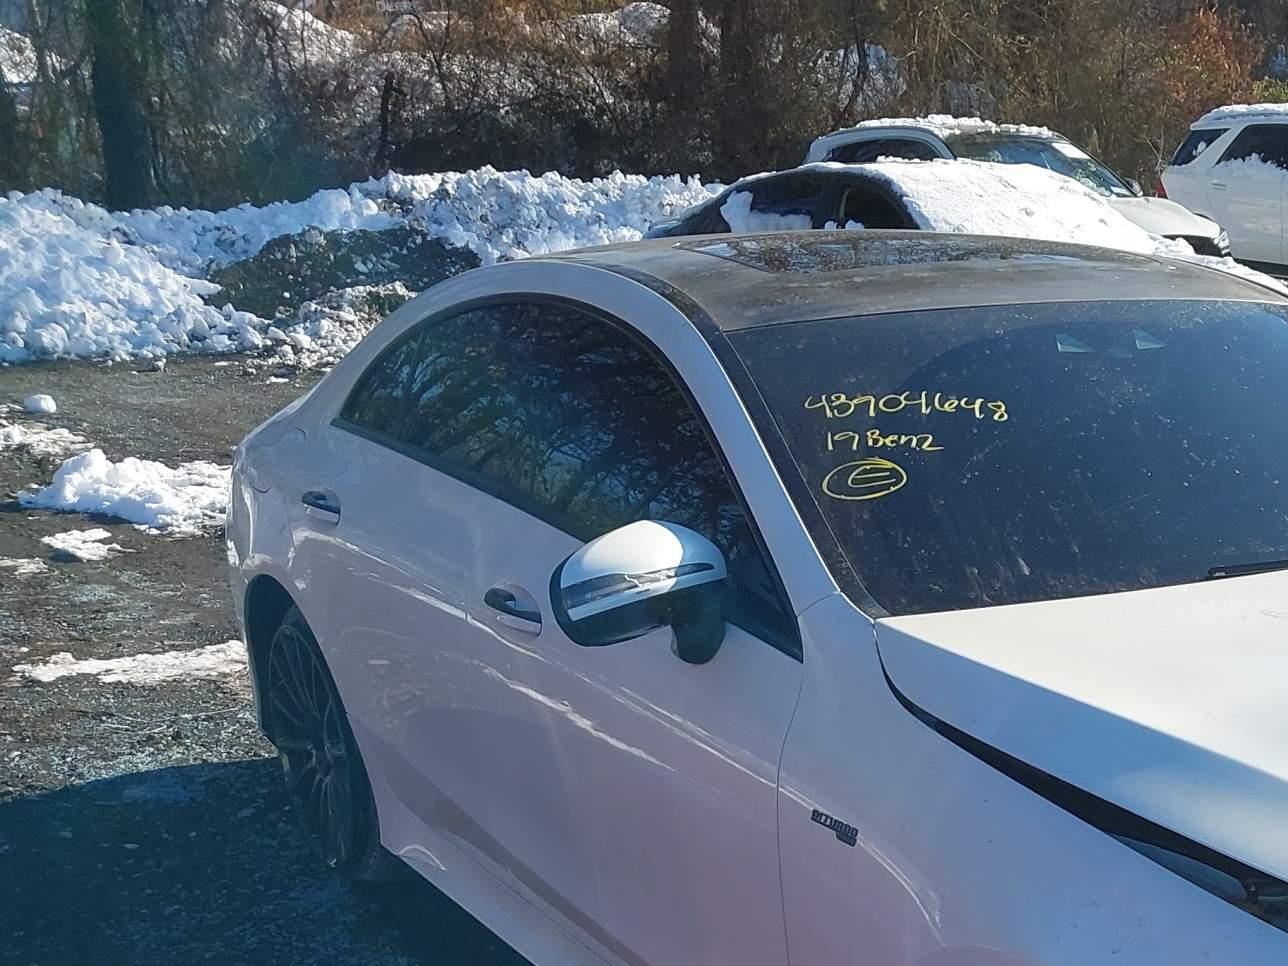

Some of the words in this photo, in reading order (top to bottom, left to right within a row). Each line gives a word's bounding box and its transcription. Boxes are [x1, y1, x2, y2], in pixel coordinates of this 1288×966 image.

[804, 390, 1009, 421] 43904648
[826, 431, 859, 450] 19
[866, 428, 945, 451] Benz
